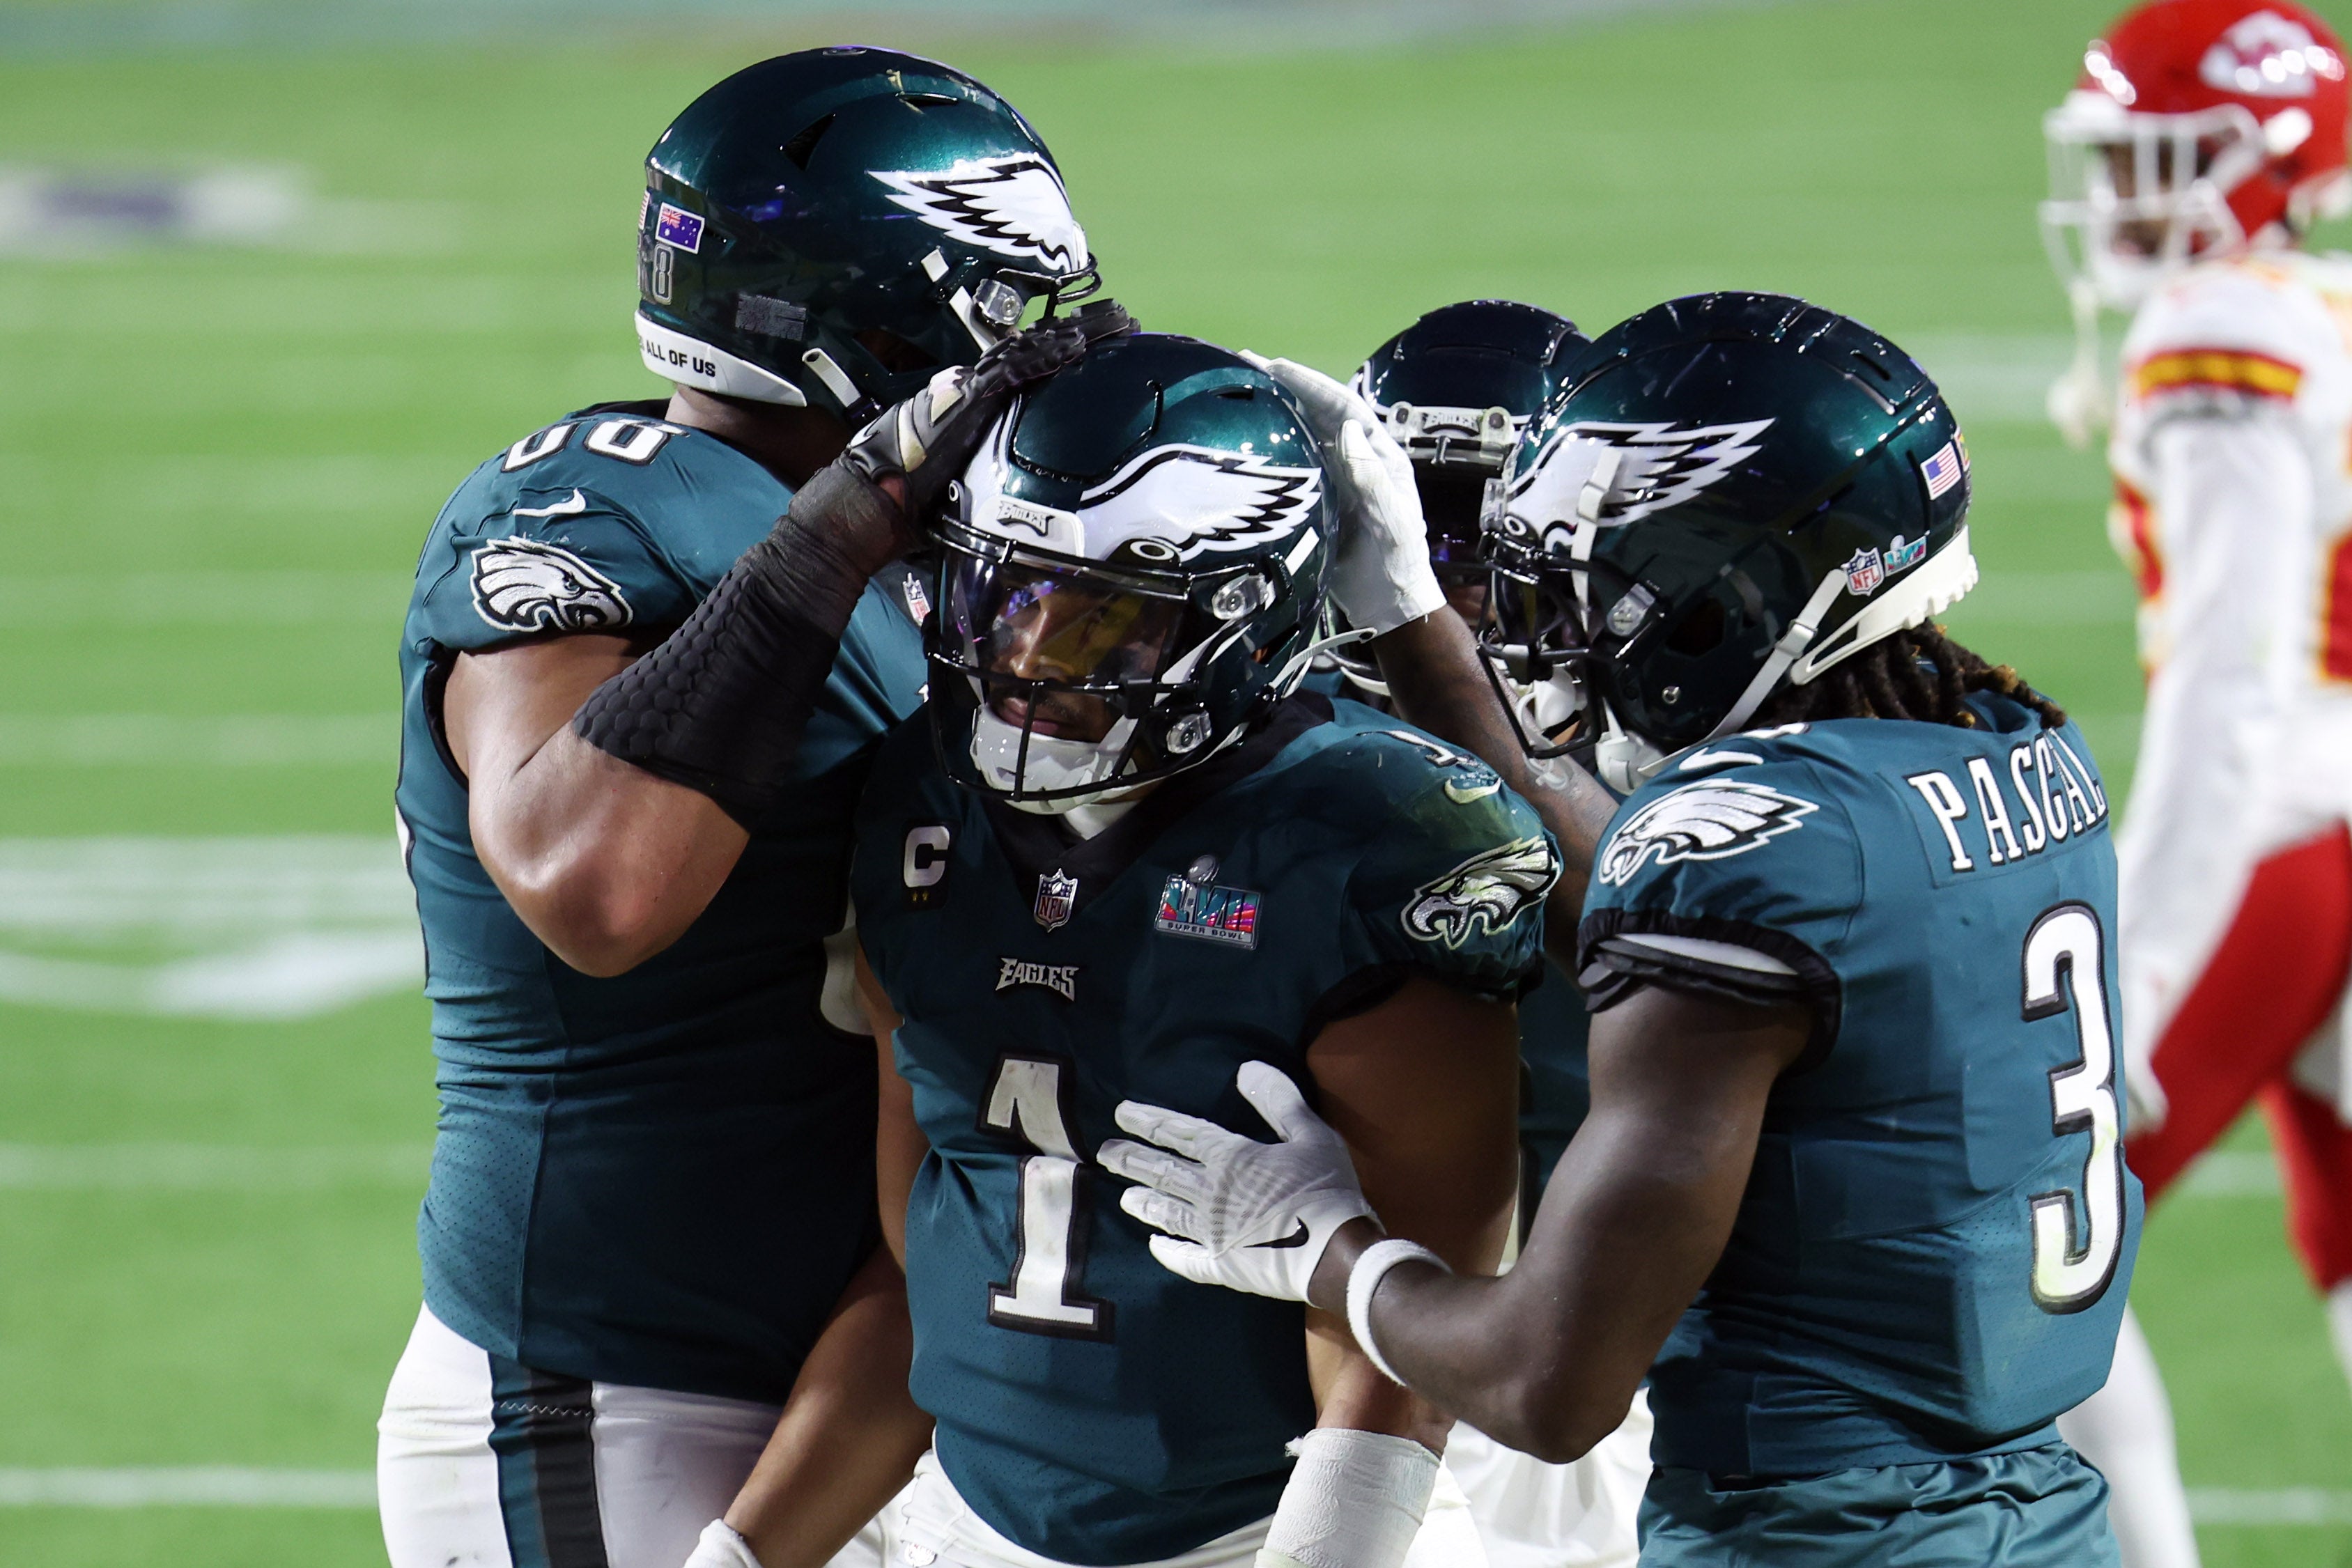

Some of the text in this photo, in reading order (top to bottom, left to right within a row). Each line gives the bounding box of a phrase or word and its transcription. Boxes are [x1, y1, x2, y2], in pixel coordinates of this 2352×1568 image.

[645, 339, 665, 361] ALL
[669, 349, 688, 368] OF
[693, 357, 716, 378] US
[1850, 567, 1879, 589] NFL
[1903, 728, 2108, 872] PASCAL
[904, 825, 950, 888] C
[1039, 896, 1064, 920] NFL
[1167, 922, 1244, 940] SUPER BOWL
[995, 957, 1080, 1002] EAGLES
[2022, 899, 2126, 1315] 3
[980, 1051, 1111, 1339] 1
